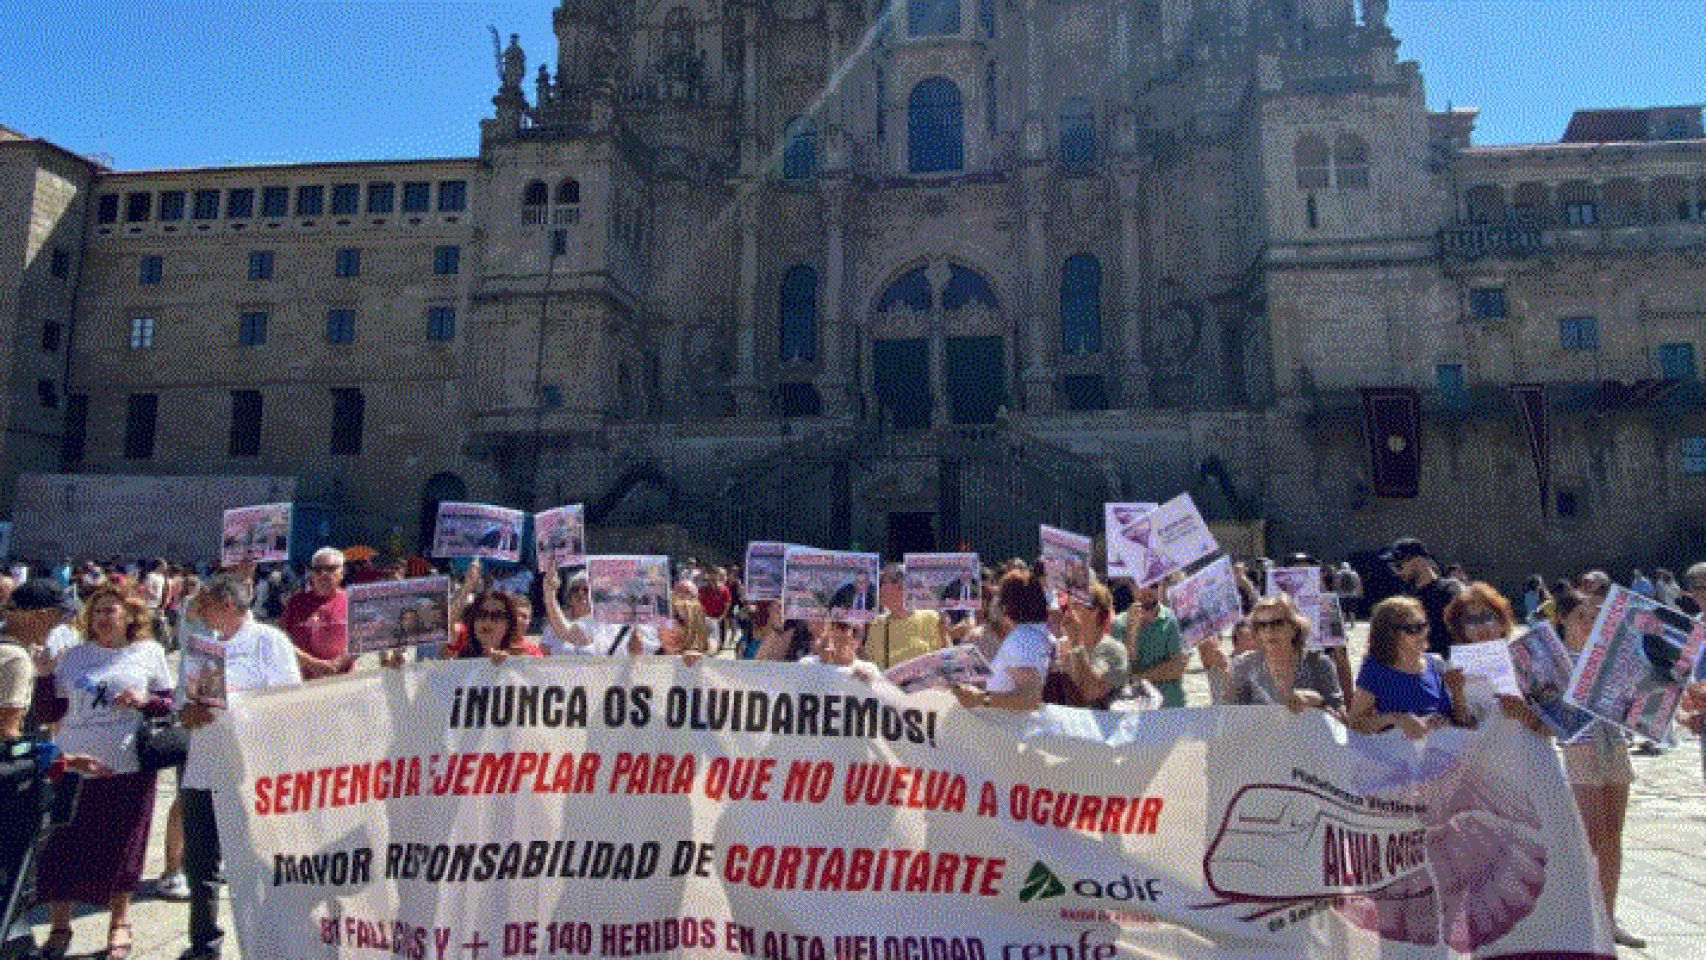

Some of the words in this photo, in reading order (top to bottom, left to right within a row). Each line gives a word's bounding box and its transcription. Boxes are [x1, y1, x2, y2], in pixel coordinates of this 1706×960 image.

[450, 686, 587, 729] ¡NUNCA
[602, 686, 651, 729] OS
[665, 686, 938, 748] OLVIDAREMOS!
[254, 755, 420, 815] SENTENCIA
[609, 752, 697, 795] PARA
[704, 755, 775, 802] QUE
[783, 759, 835, 804] NO
[844, 762, 966, 813] VUELVA
[977, 780, 998, 818] A
[1010, 783, 1164, 834] OCURRIR
[671, 841, 714, 878] DE
[724, 843, 1007, 897] CORTABITARTE
[1323, 822, 1384, 887] ALVIA
[1073, 873, 1164, 902] adif
[435, 927, 452, 960] Y
[462, 930, 490, 960] +
[503, 921, 539, 957] DE
[546, 920, 593, 956] 140
[600, 917, 717, 958] HERIDOS
[725, 921, 757, 956] EN
[763, 929, 826, 960] ALTA
[834, 934, 986, 960] VELOCIDAD
[1002, 929, 1119, 960] renfe
